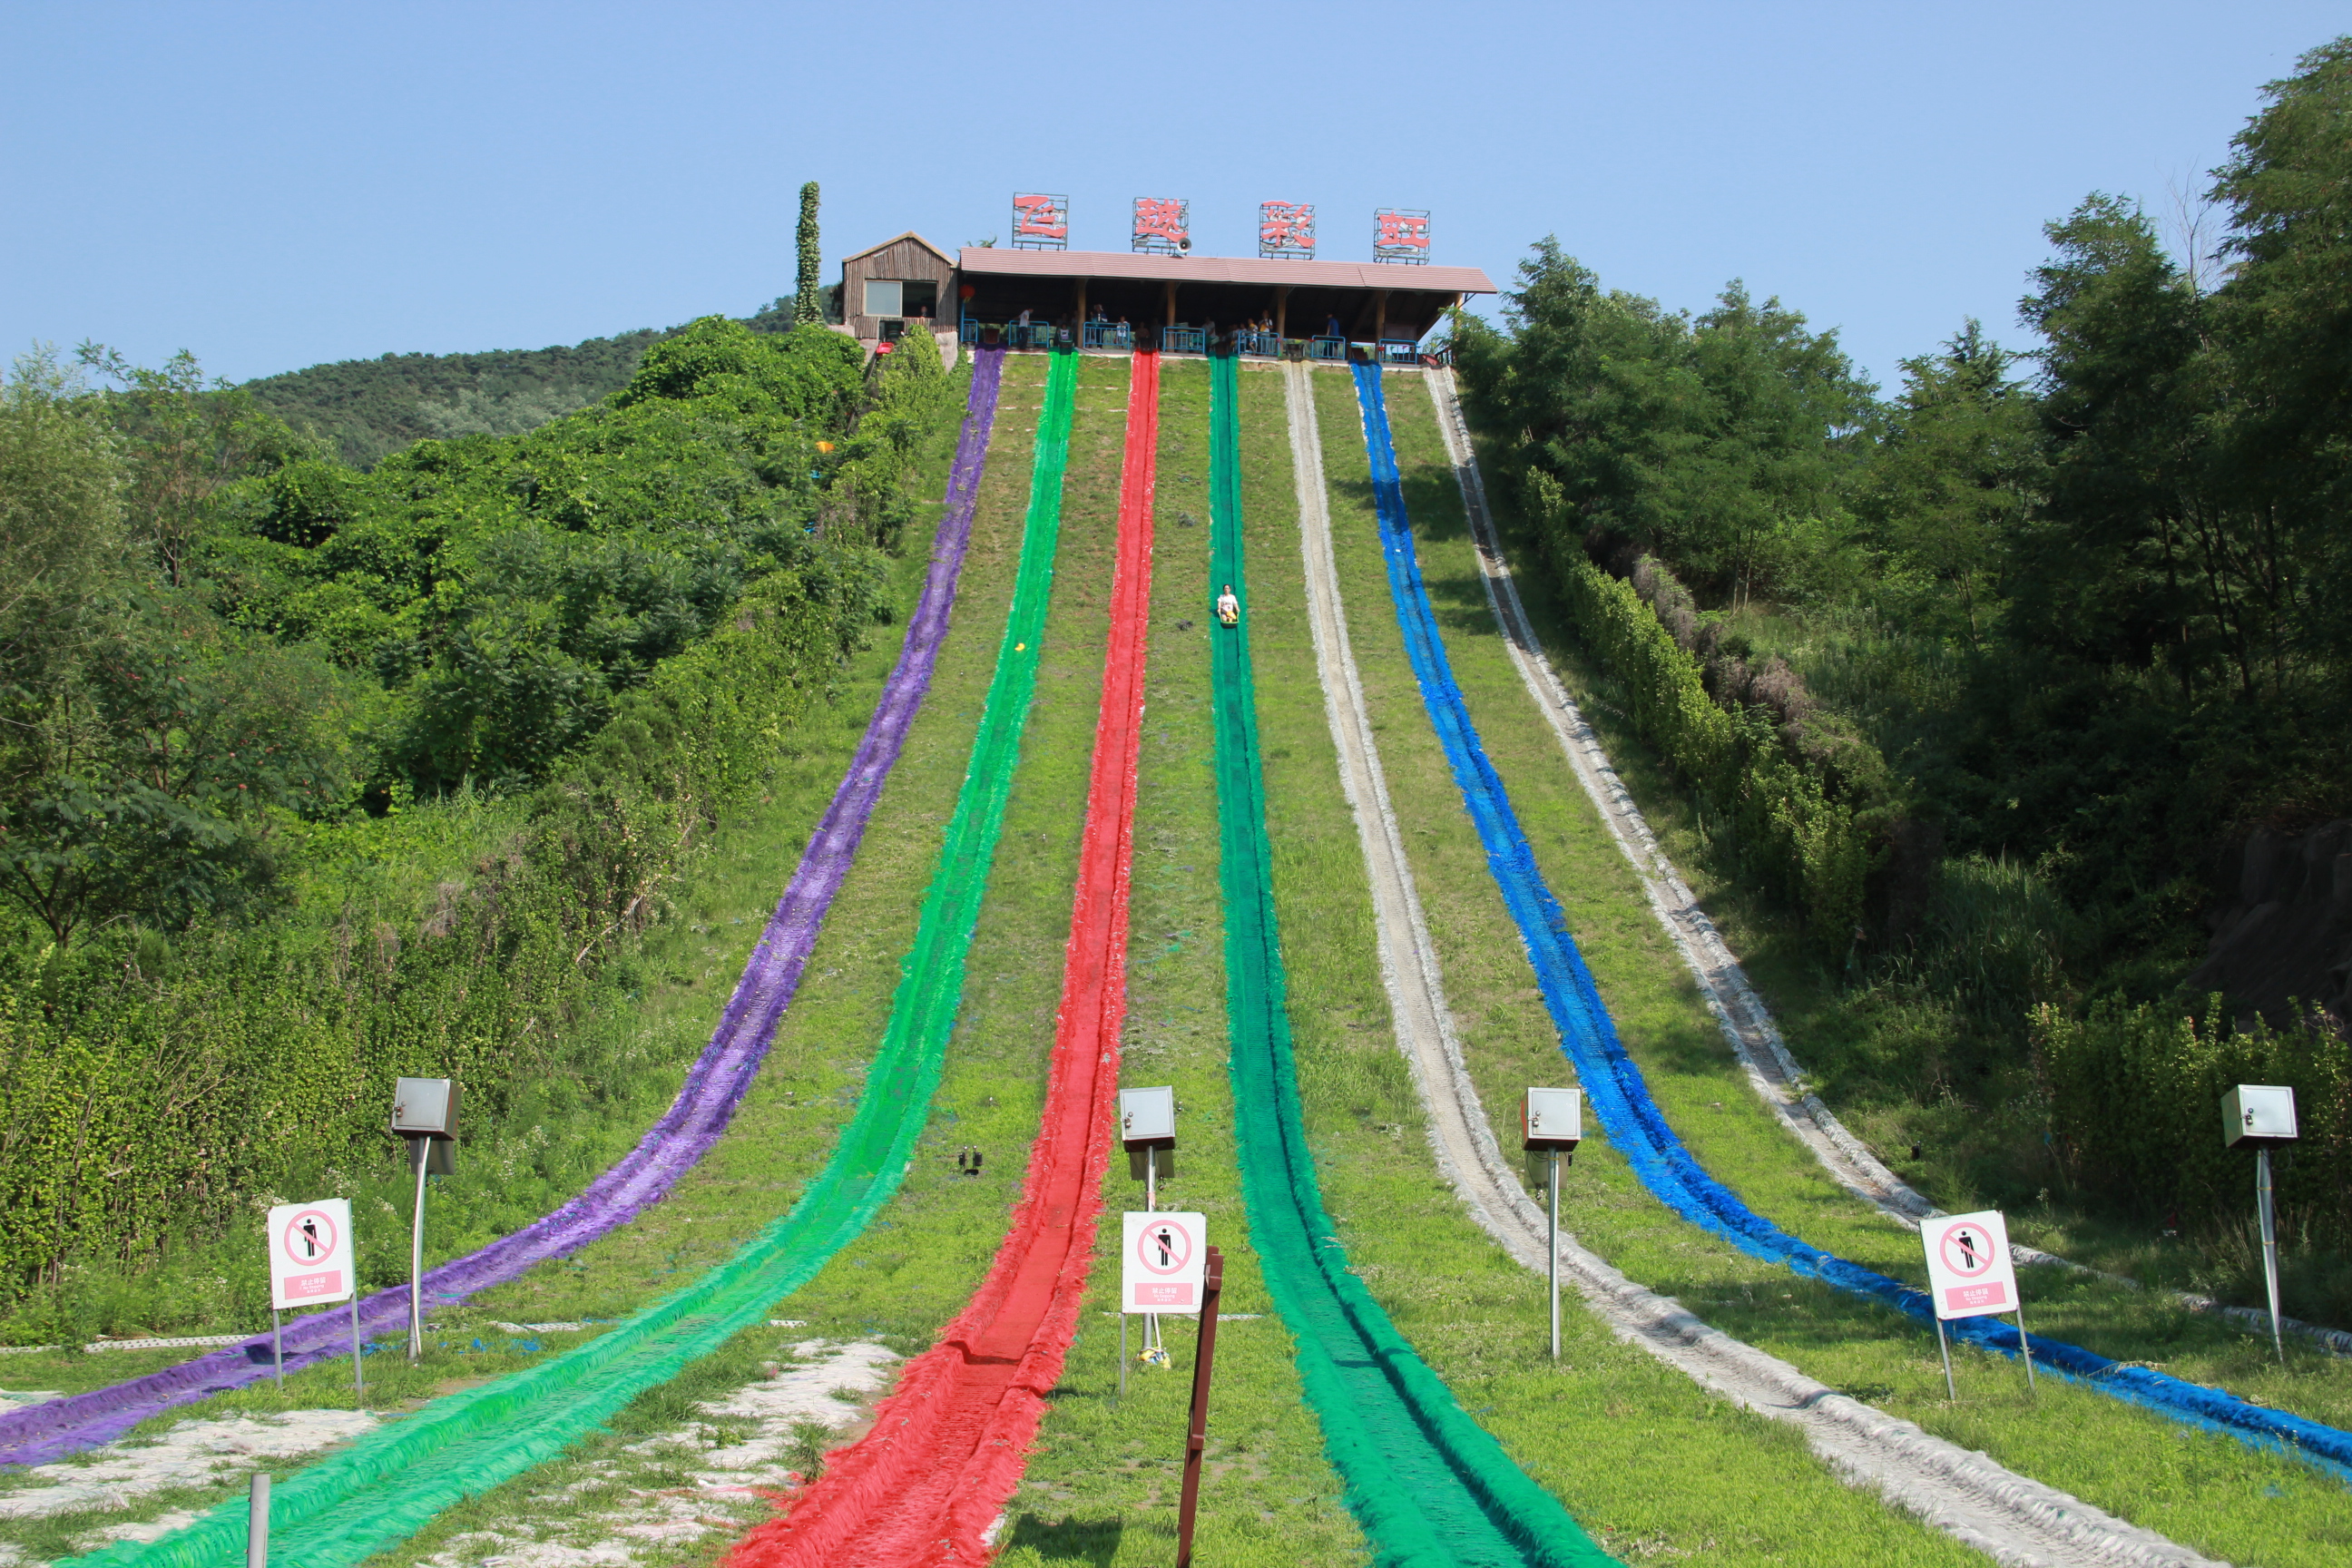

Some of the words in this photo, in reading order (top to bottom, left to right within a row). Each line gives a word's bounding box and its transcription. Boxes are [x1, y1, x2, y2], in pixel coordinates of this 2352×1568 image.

[1014, 195, 1430, 249] 飞越彩虹
[301, 1277, 327, 1286] 禁止停留
[1963, 1289, 1988, 1297] 禁止停留
